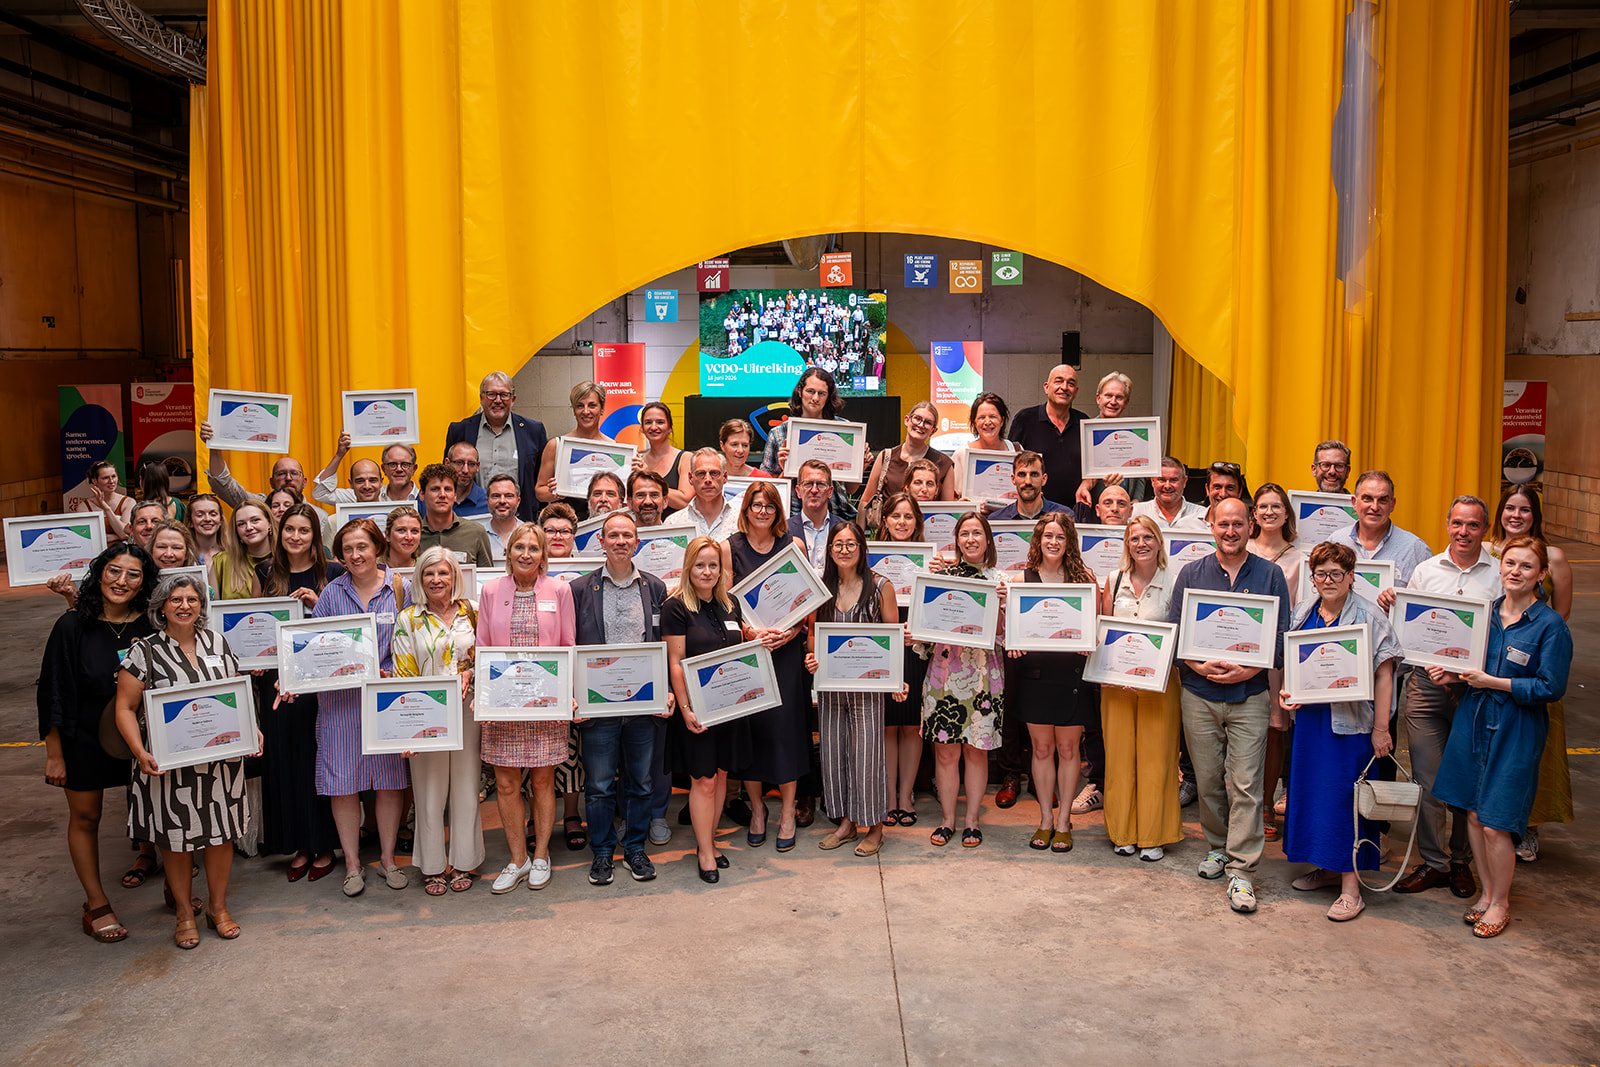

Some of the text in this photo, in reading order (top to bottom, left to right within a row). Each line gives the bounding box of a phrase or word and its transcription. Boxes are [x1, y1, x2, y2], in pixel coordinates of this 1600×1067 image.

[906, 255, 914, 265] 16
[993, 253, 1000, 262] 13
[951, 262, 958, 270] 12
[647, 291, 652, 300] 6
[705, 363, 803, 375] VCDO-Uitreiking
